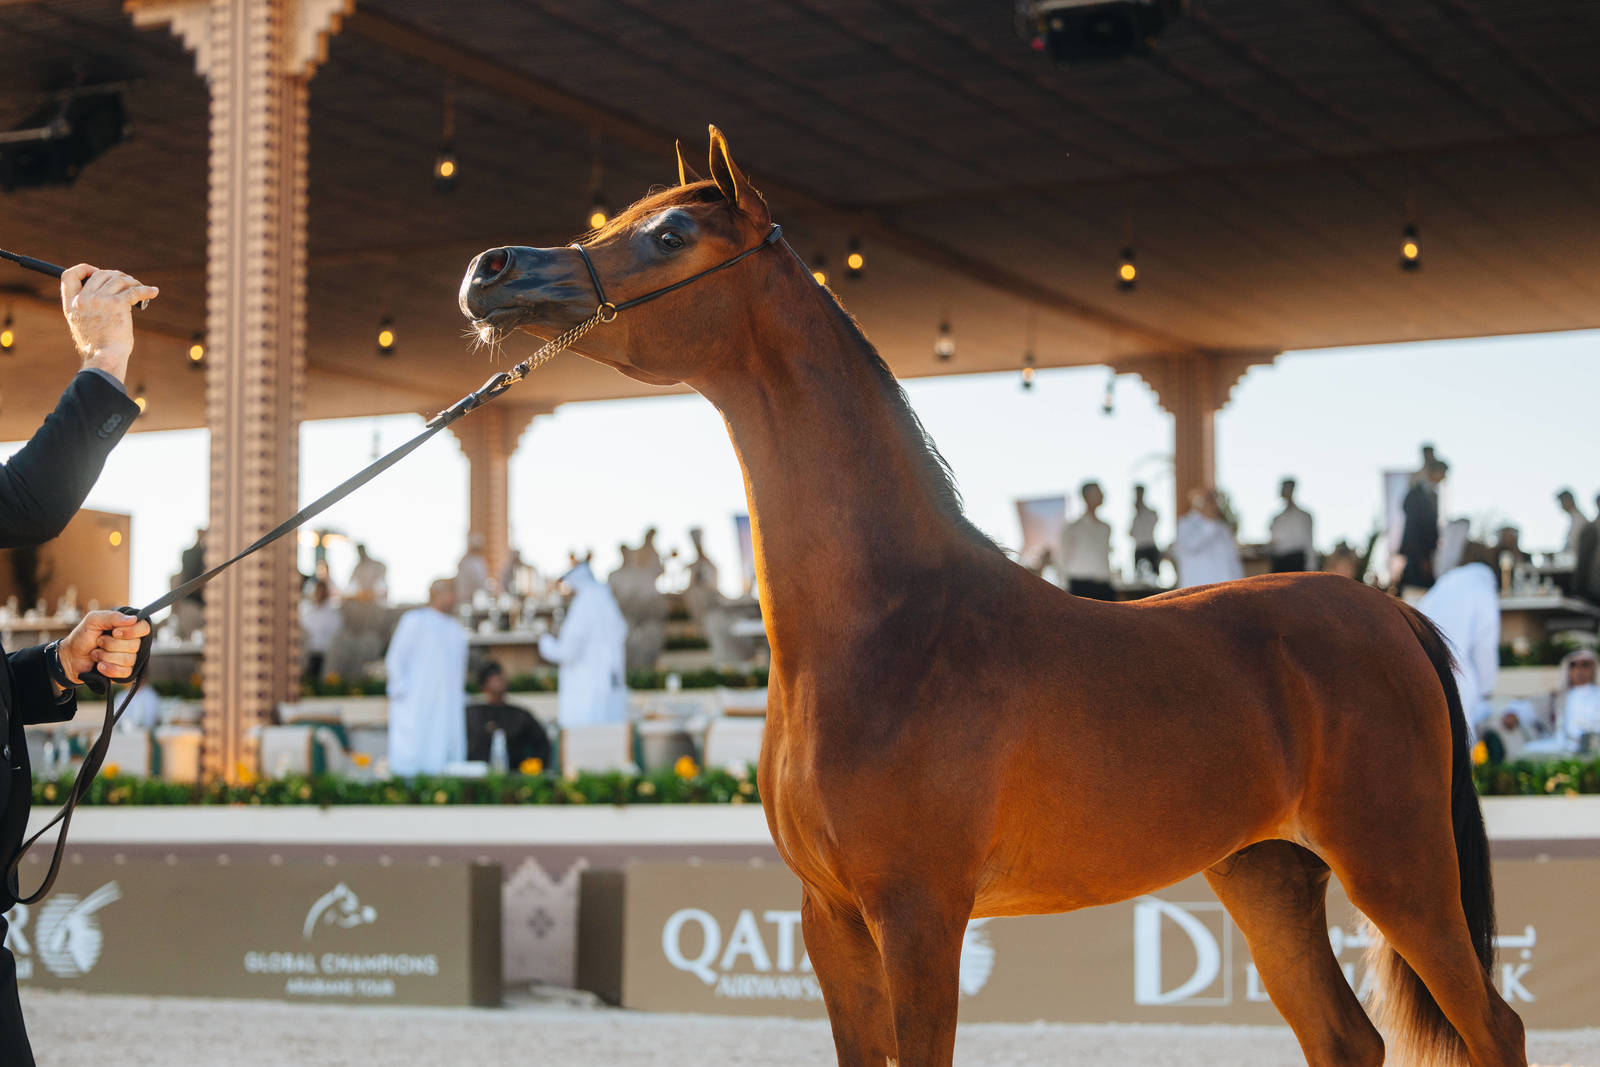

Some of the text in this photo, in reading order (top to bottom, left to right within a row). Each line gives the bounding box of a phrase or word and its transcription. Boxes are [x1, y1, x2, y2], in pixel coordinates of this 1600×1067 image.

[244, 951, 438, 976] GLOBAL CHAMPIONS
[356, 979, 396, 997] TOUR
